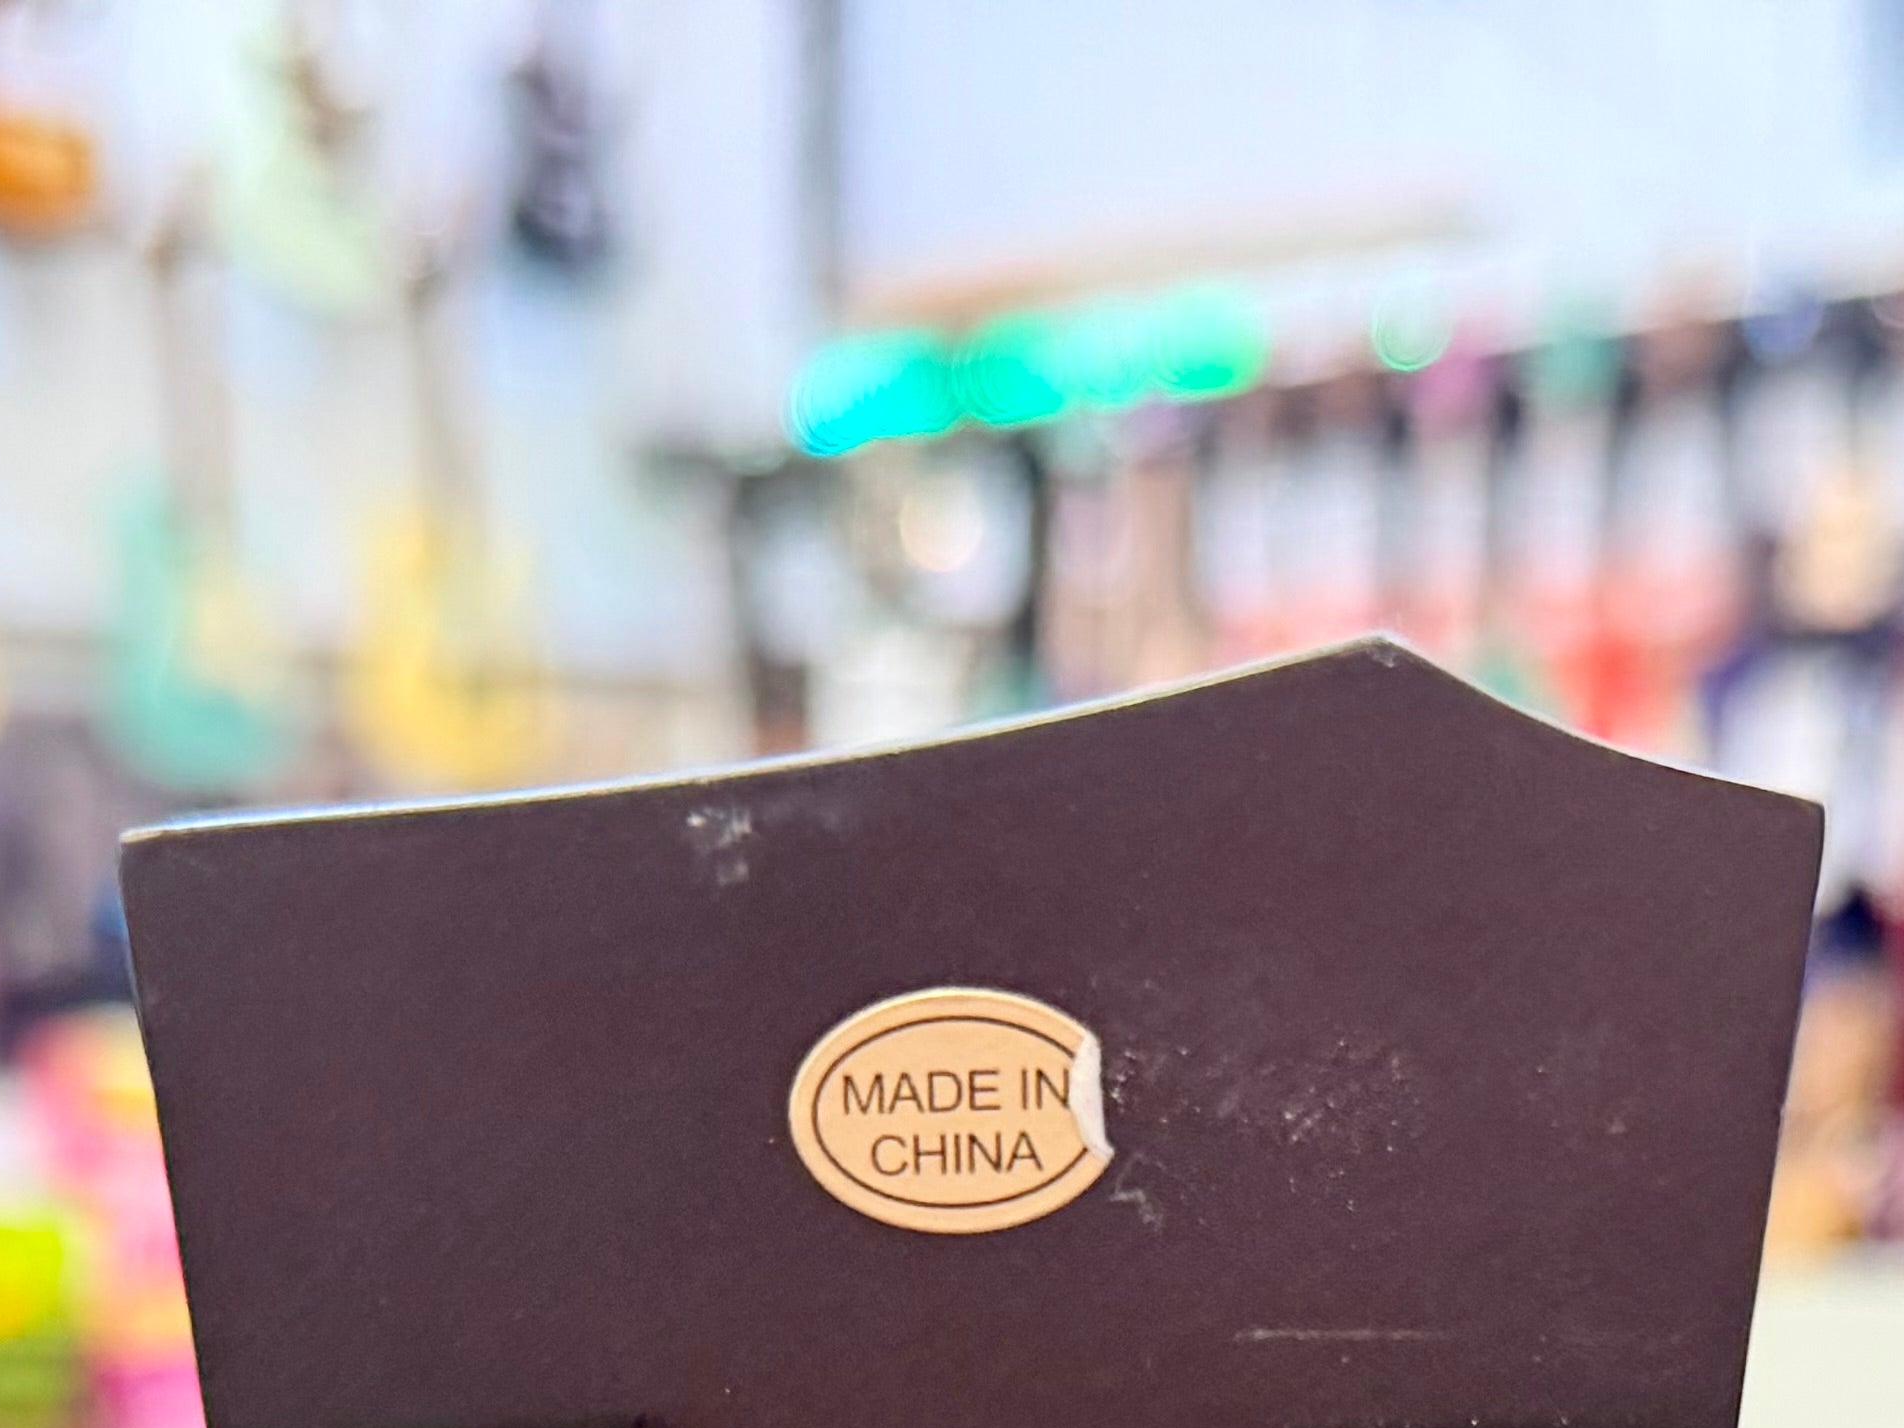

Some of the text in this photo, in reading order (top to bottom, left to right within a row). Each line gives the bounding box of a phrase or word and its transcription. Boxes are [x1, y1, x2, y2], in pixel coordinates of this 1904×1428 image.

[842, 1067, 1070, 1115] MADE IN
[870, 1131, 1043, 1177] CHINA
